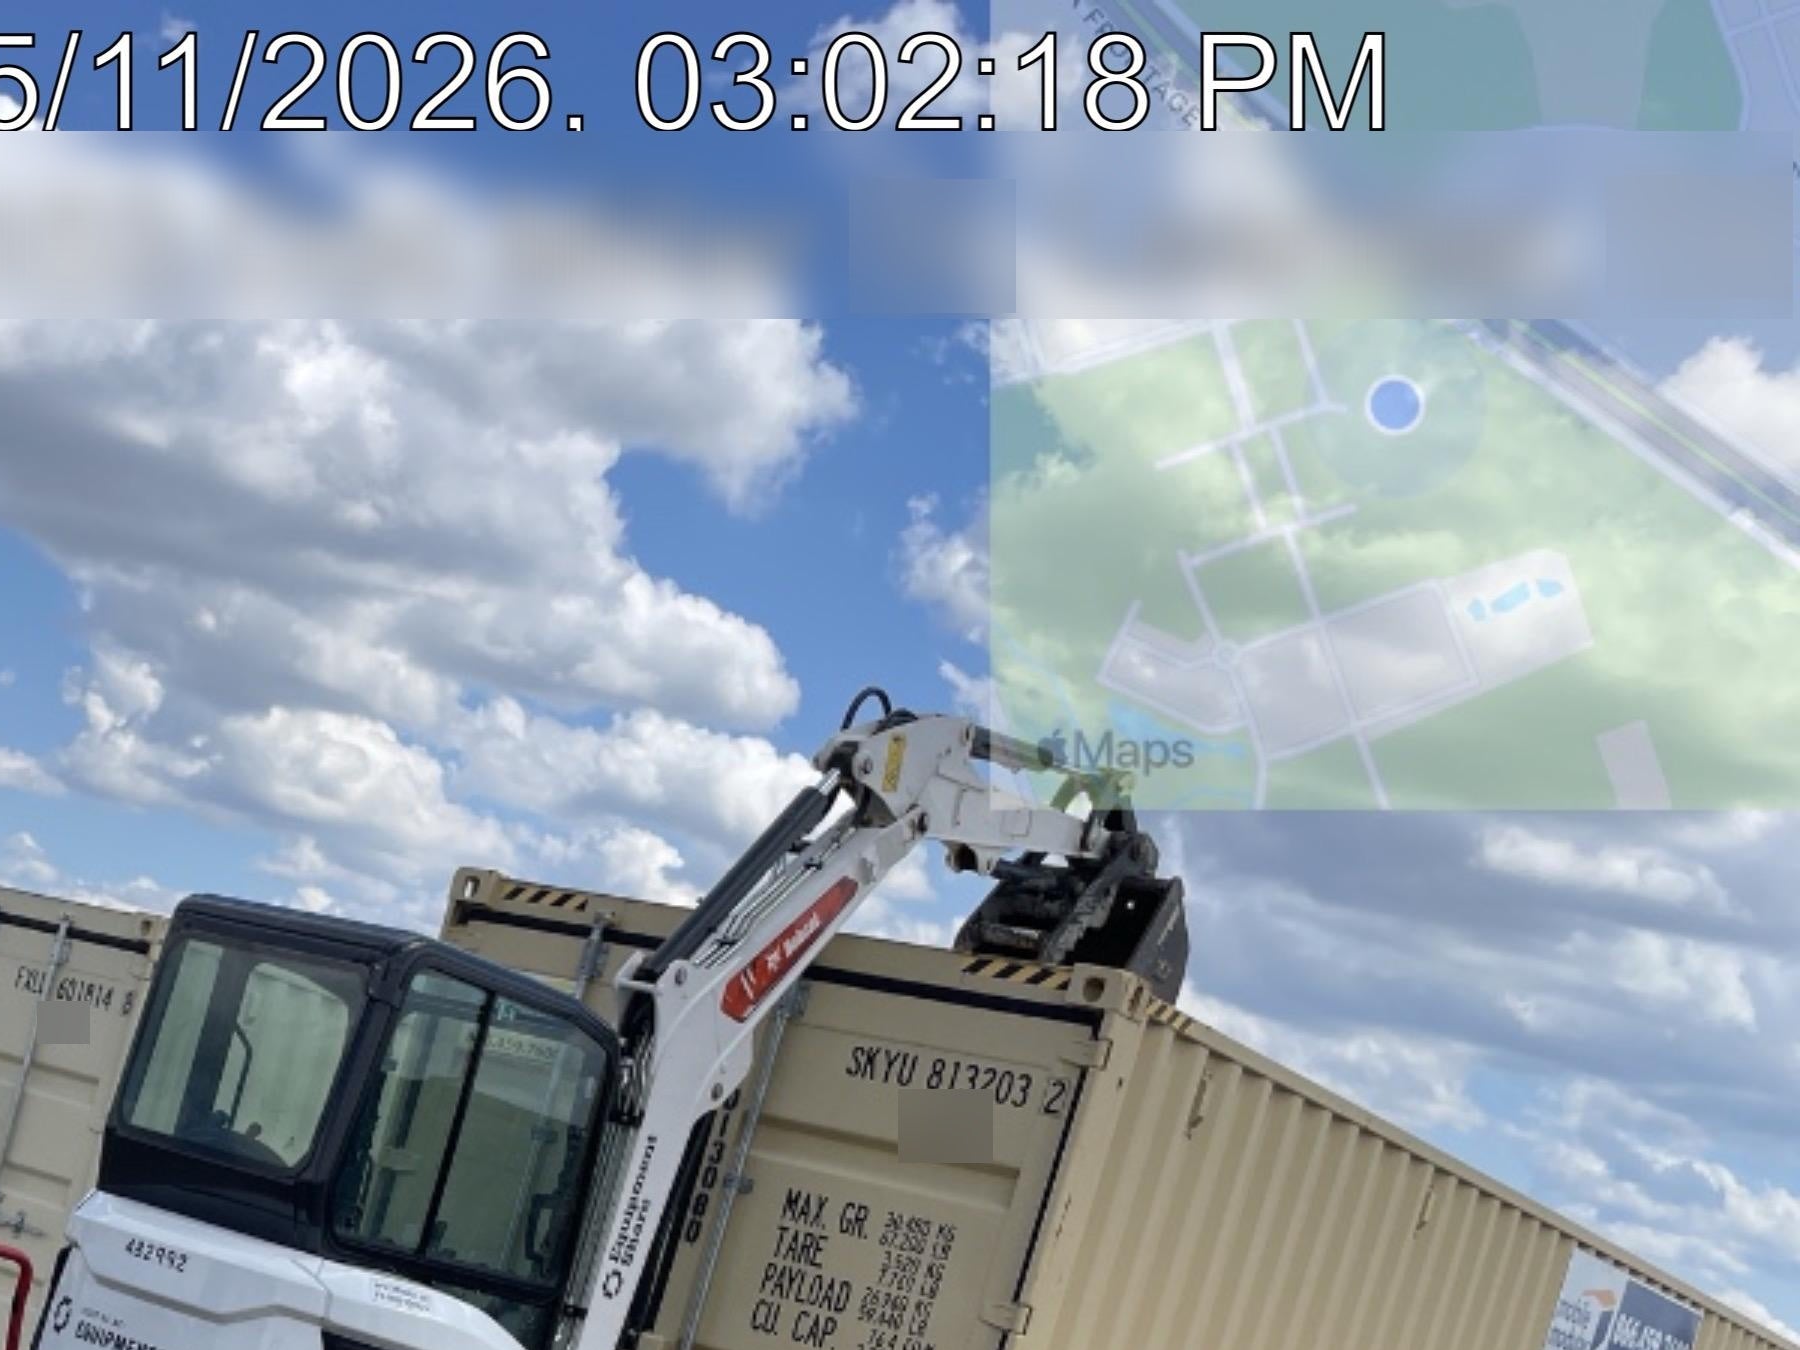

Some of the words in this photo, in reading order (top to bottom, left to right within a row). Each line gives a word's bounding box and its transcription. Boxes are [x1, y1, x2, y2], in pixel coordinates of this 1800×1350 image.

[845, 1044, 921, 1088] SKYU
[1044, 1078, 1069, 1115] 2
[773, 1225, 829, 1269] TARE
[760, 1261, 853, 1314] PAYLOAD
